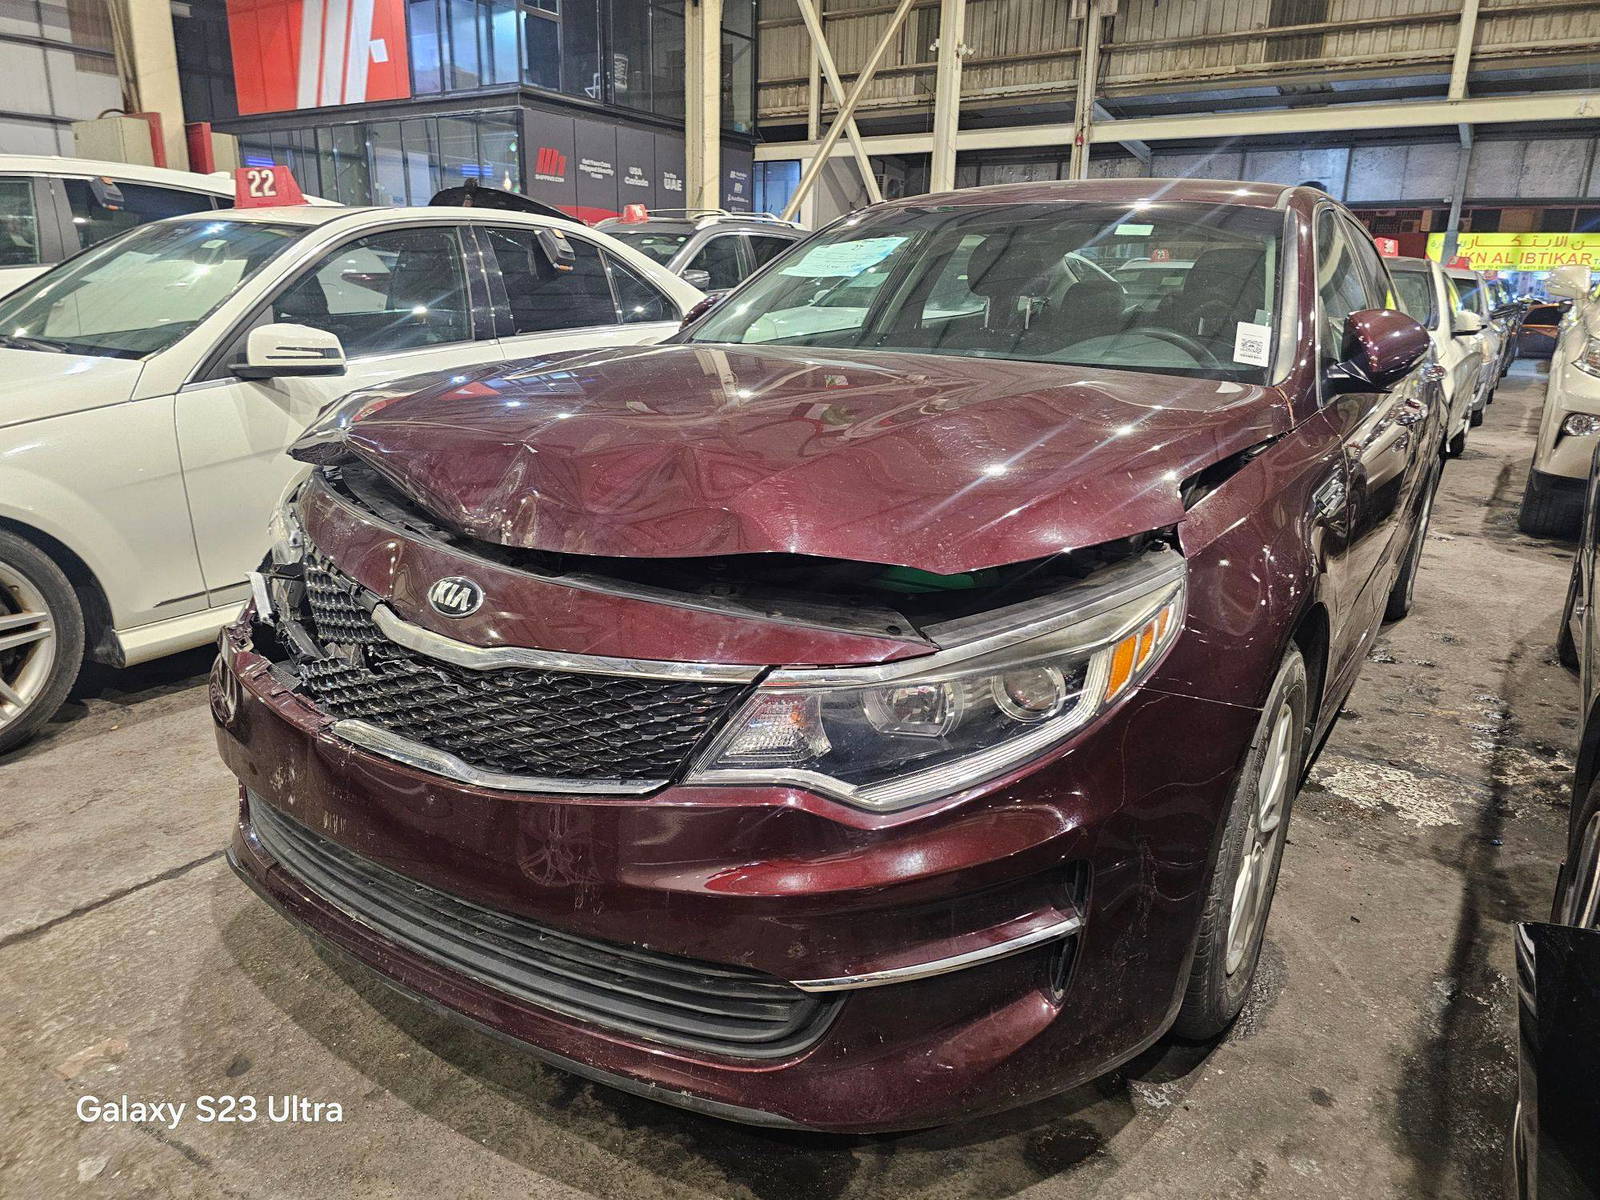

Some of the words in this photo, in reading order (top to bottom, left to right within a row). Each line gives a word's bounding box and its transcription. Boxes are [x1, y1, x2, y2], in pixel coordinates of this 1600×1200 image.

[247, 169, 277, 198] 22
[664, 179, 682, 191] UAE
[1492, 252, 1514, 264] AL
[1519, 252, 1593, 264] IBTIKAR
[433, 581, 472, 611] KIA
